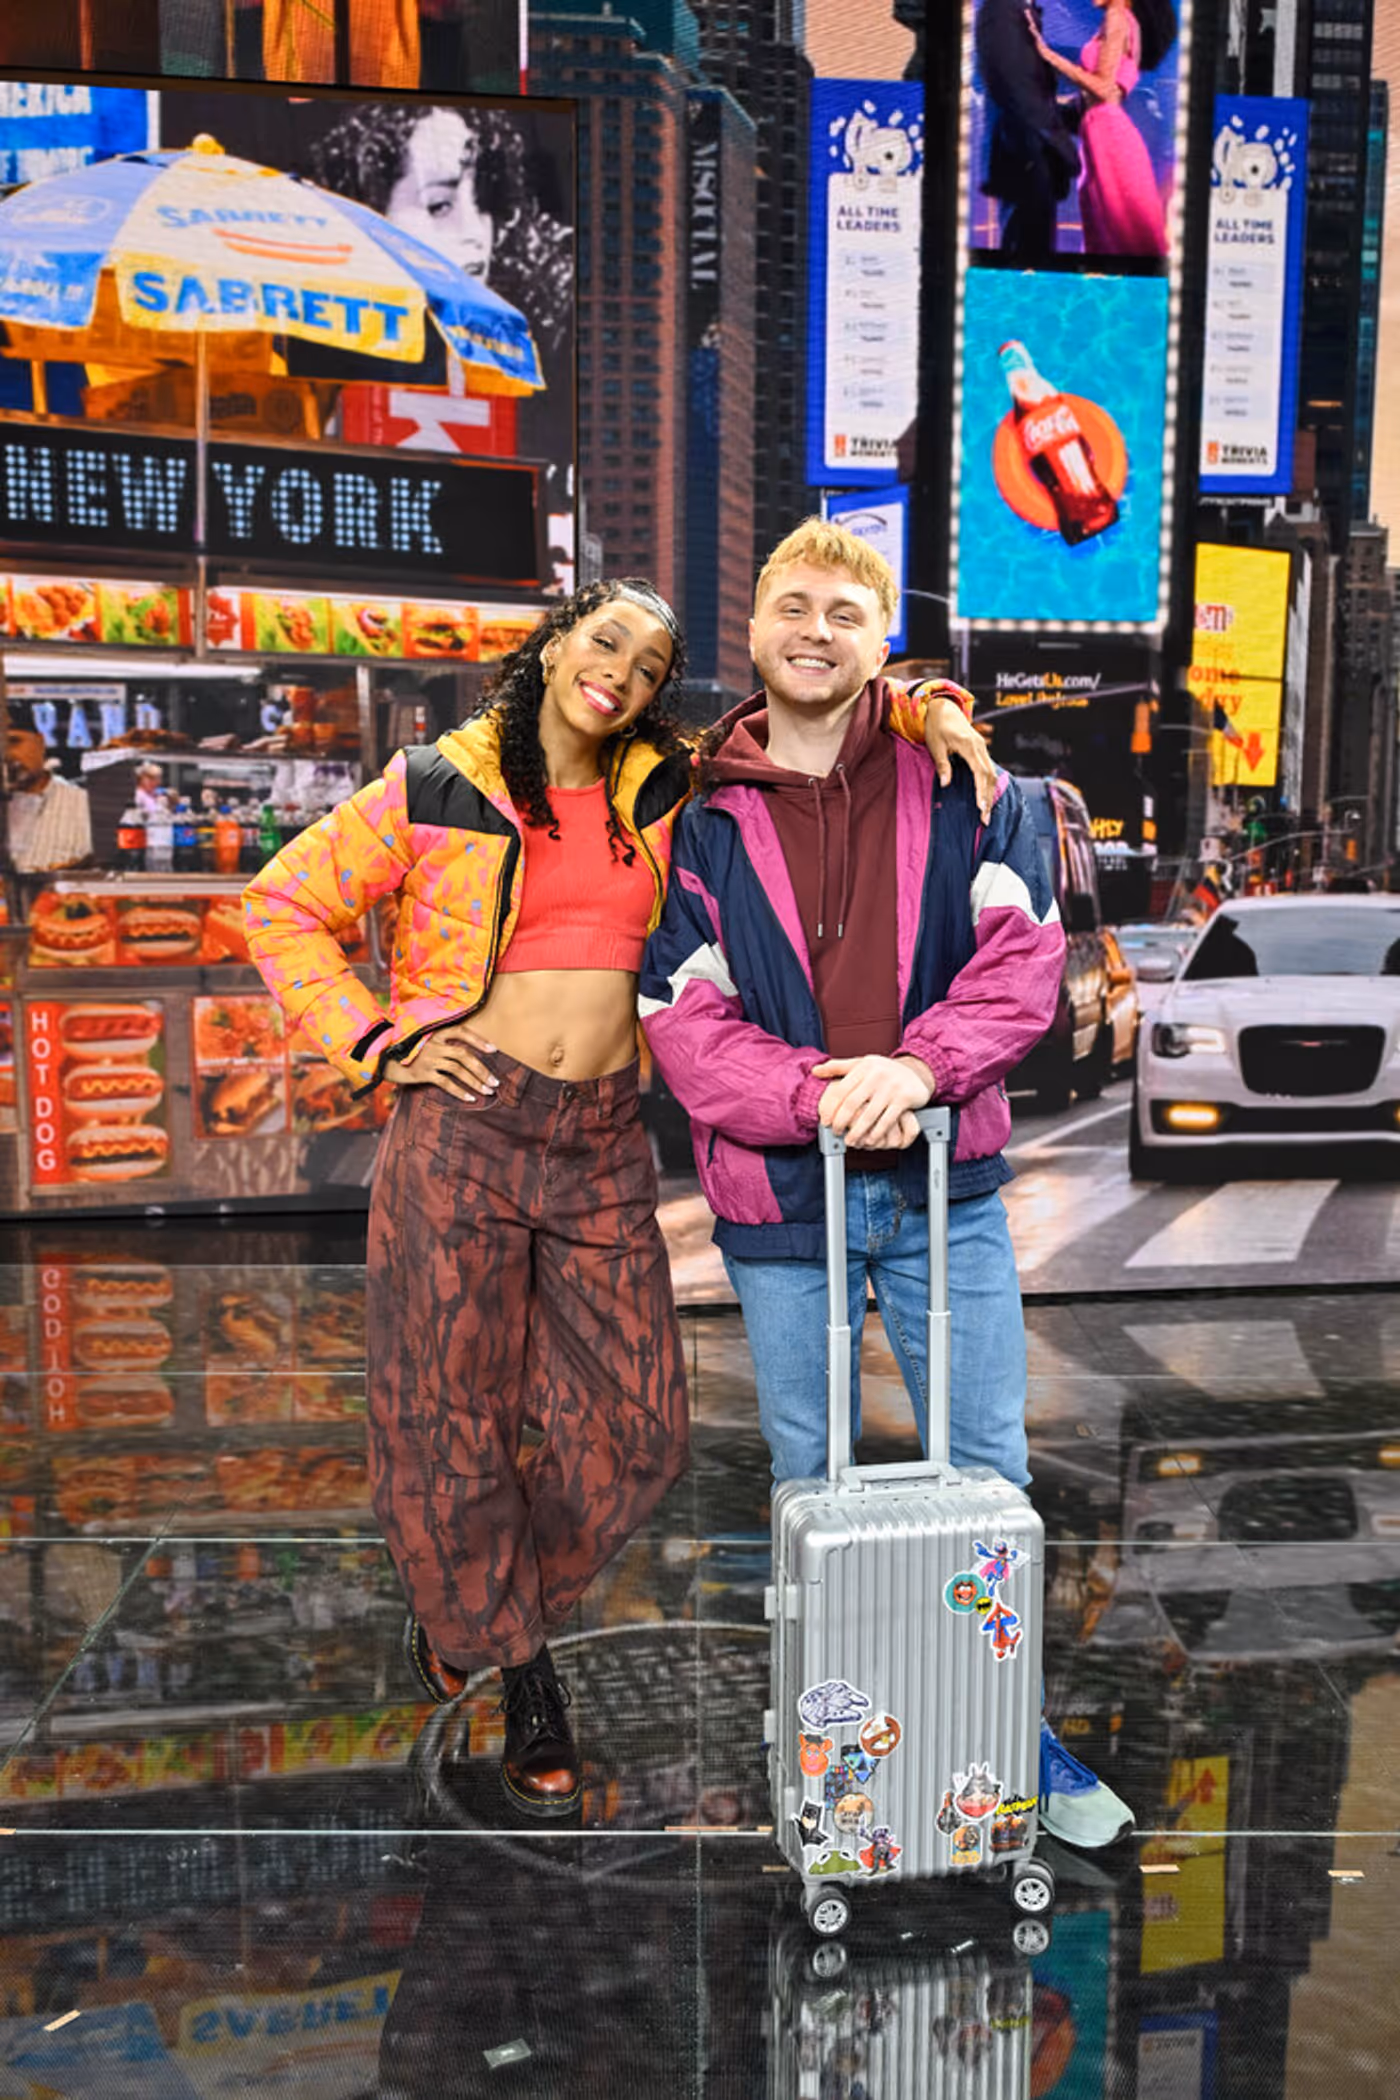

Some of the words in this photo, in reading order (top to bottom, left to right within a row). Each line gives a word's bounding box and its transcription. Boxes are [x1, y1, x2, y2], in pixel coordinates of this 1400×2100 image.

[838, 206, 863, 217] ALL
[867, 206, 898, 218] TIME
[836, 220, 902, 232] LEADERS
[1216, 218, 1238, 230] ALL
[1214, 232, 1275, 244] LEADERS
[132, 271, 408, 342] SABRETT
[1222, 445, 1268, 456] TRIVIA
[5, 444, 187, 532] NEW
[212, 462, 442, 554] YORK
[31, 1011, 51, 1086] HOT
[35, 1097, 56, 1171] DOG
